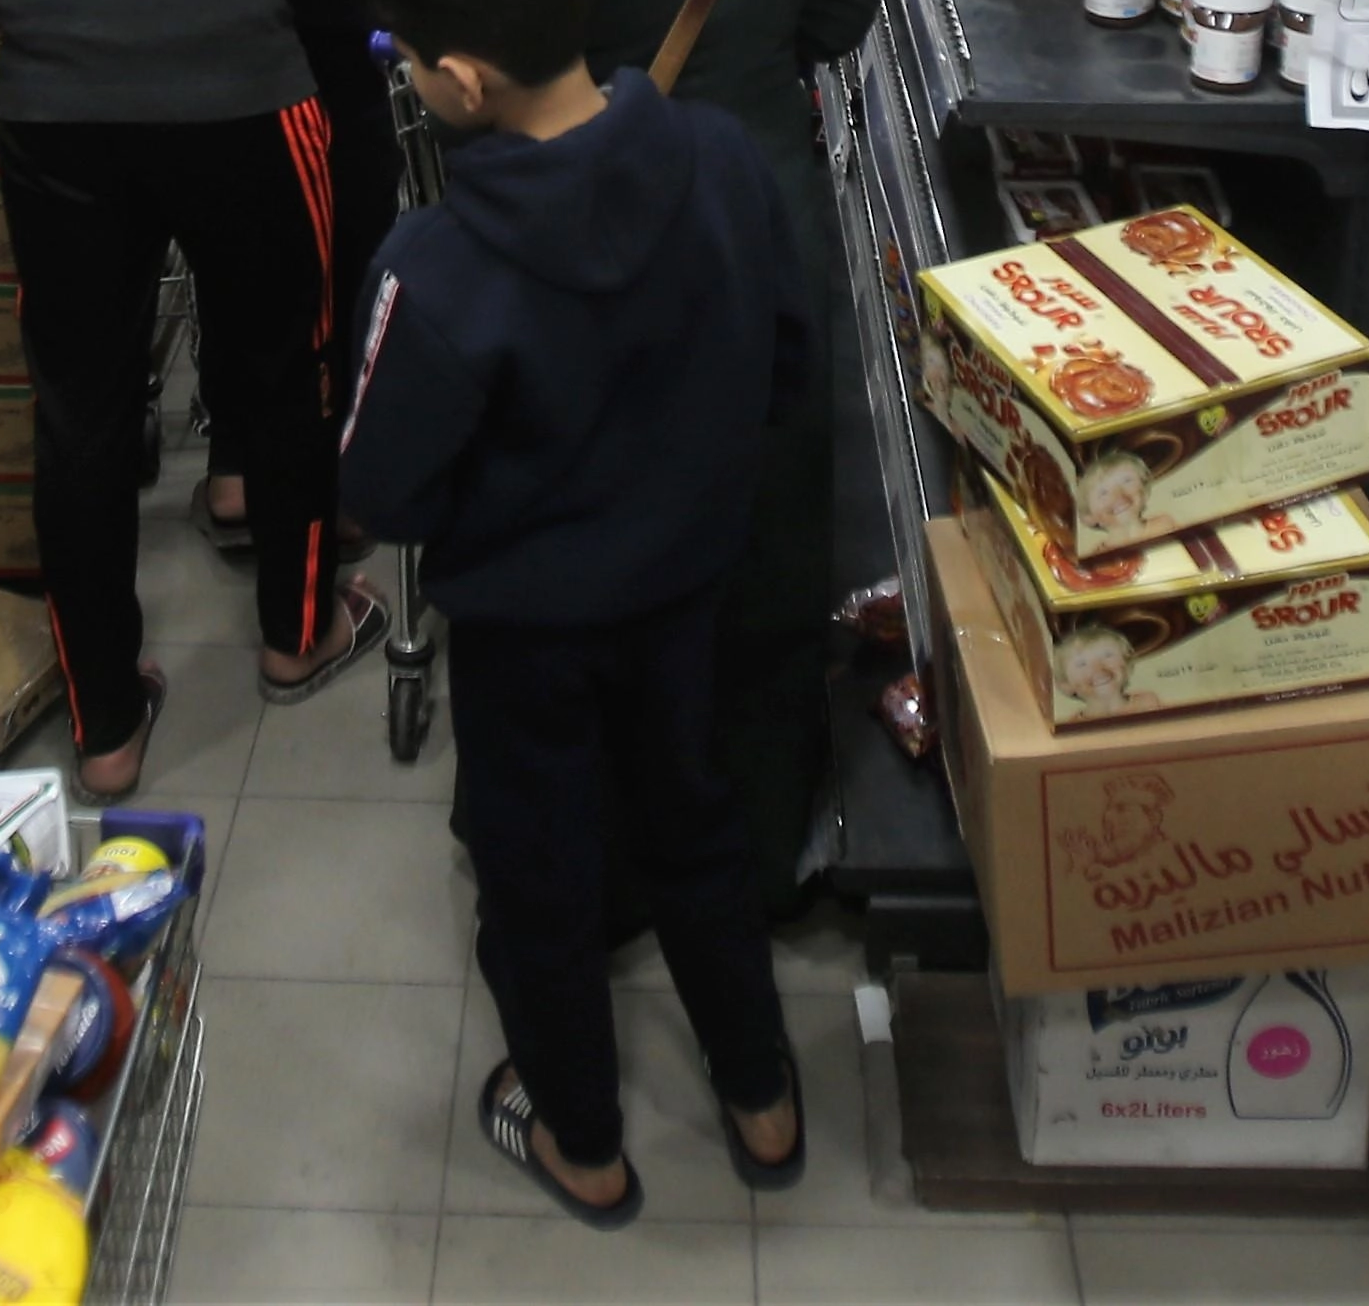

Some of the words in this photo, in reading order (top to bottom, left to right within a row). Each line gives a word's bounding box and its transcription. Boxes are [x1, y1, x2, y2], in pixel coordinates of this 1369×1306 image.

[991, 260, 1085, 332] SROUR
[1188, 284, 1294, 359] SROUR
[951, 342, 1022, 430] SROUR
[1254, 386, 1353, 437] SROUR
[1250, 588, 1361, 631] SROUR
[1110, 888, 1291, 955] Malizian
[1260, 1044, 1302, 1061] زهور
[1100, 1101, 1209, 1119] 6x2Liters
